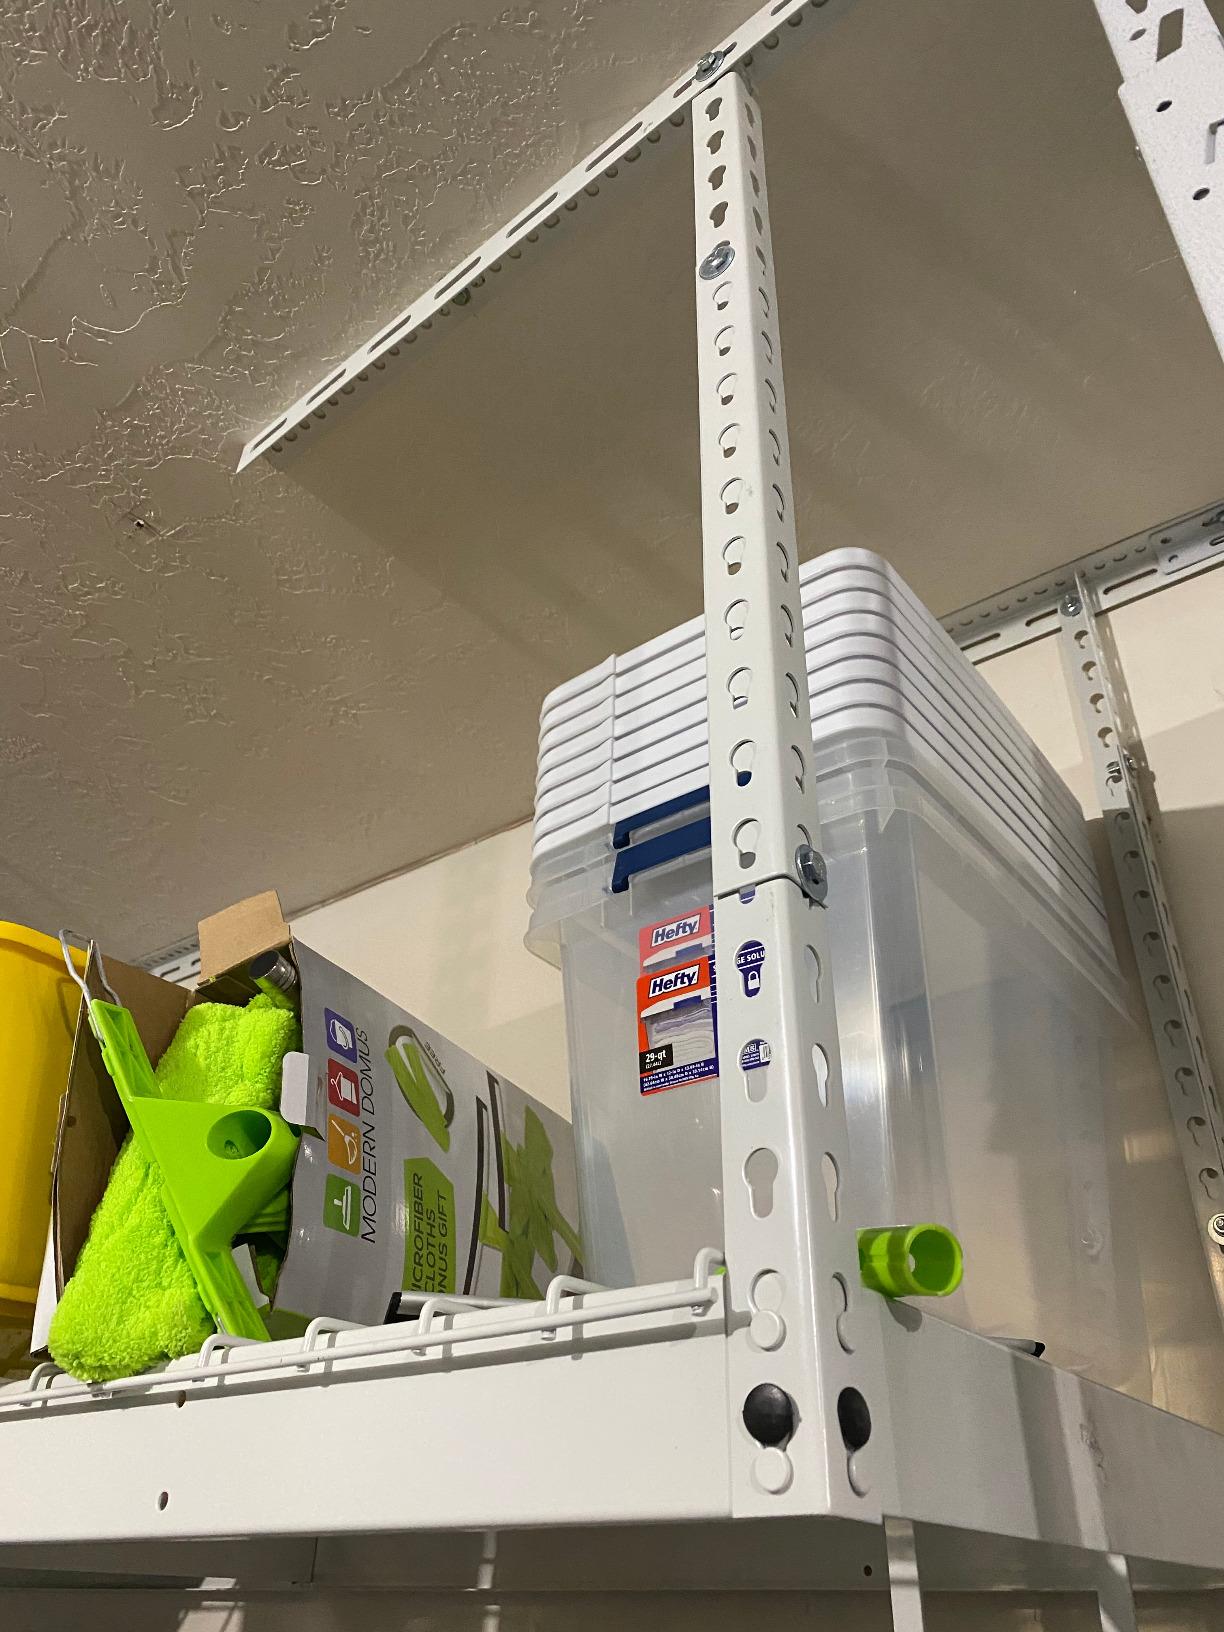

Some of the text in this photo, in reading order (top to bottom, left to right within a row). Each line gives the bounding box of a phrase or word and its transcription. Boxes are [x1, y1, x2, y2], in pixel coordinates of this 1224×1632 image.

[653, 920, 698, 944] Hefty
[651, 971, 697, 995] Hefty
[645, 1049, 667, 1063] 29-qt
[356, 1026, 377, 1244] MODERN DOMUS
[437, 1189, 448, 1237] GIFT
[408, 1172, 424, 1291] ICROFIBER
